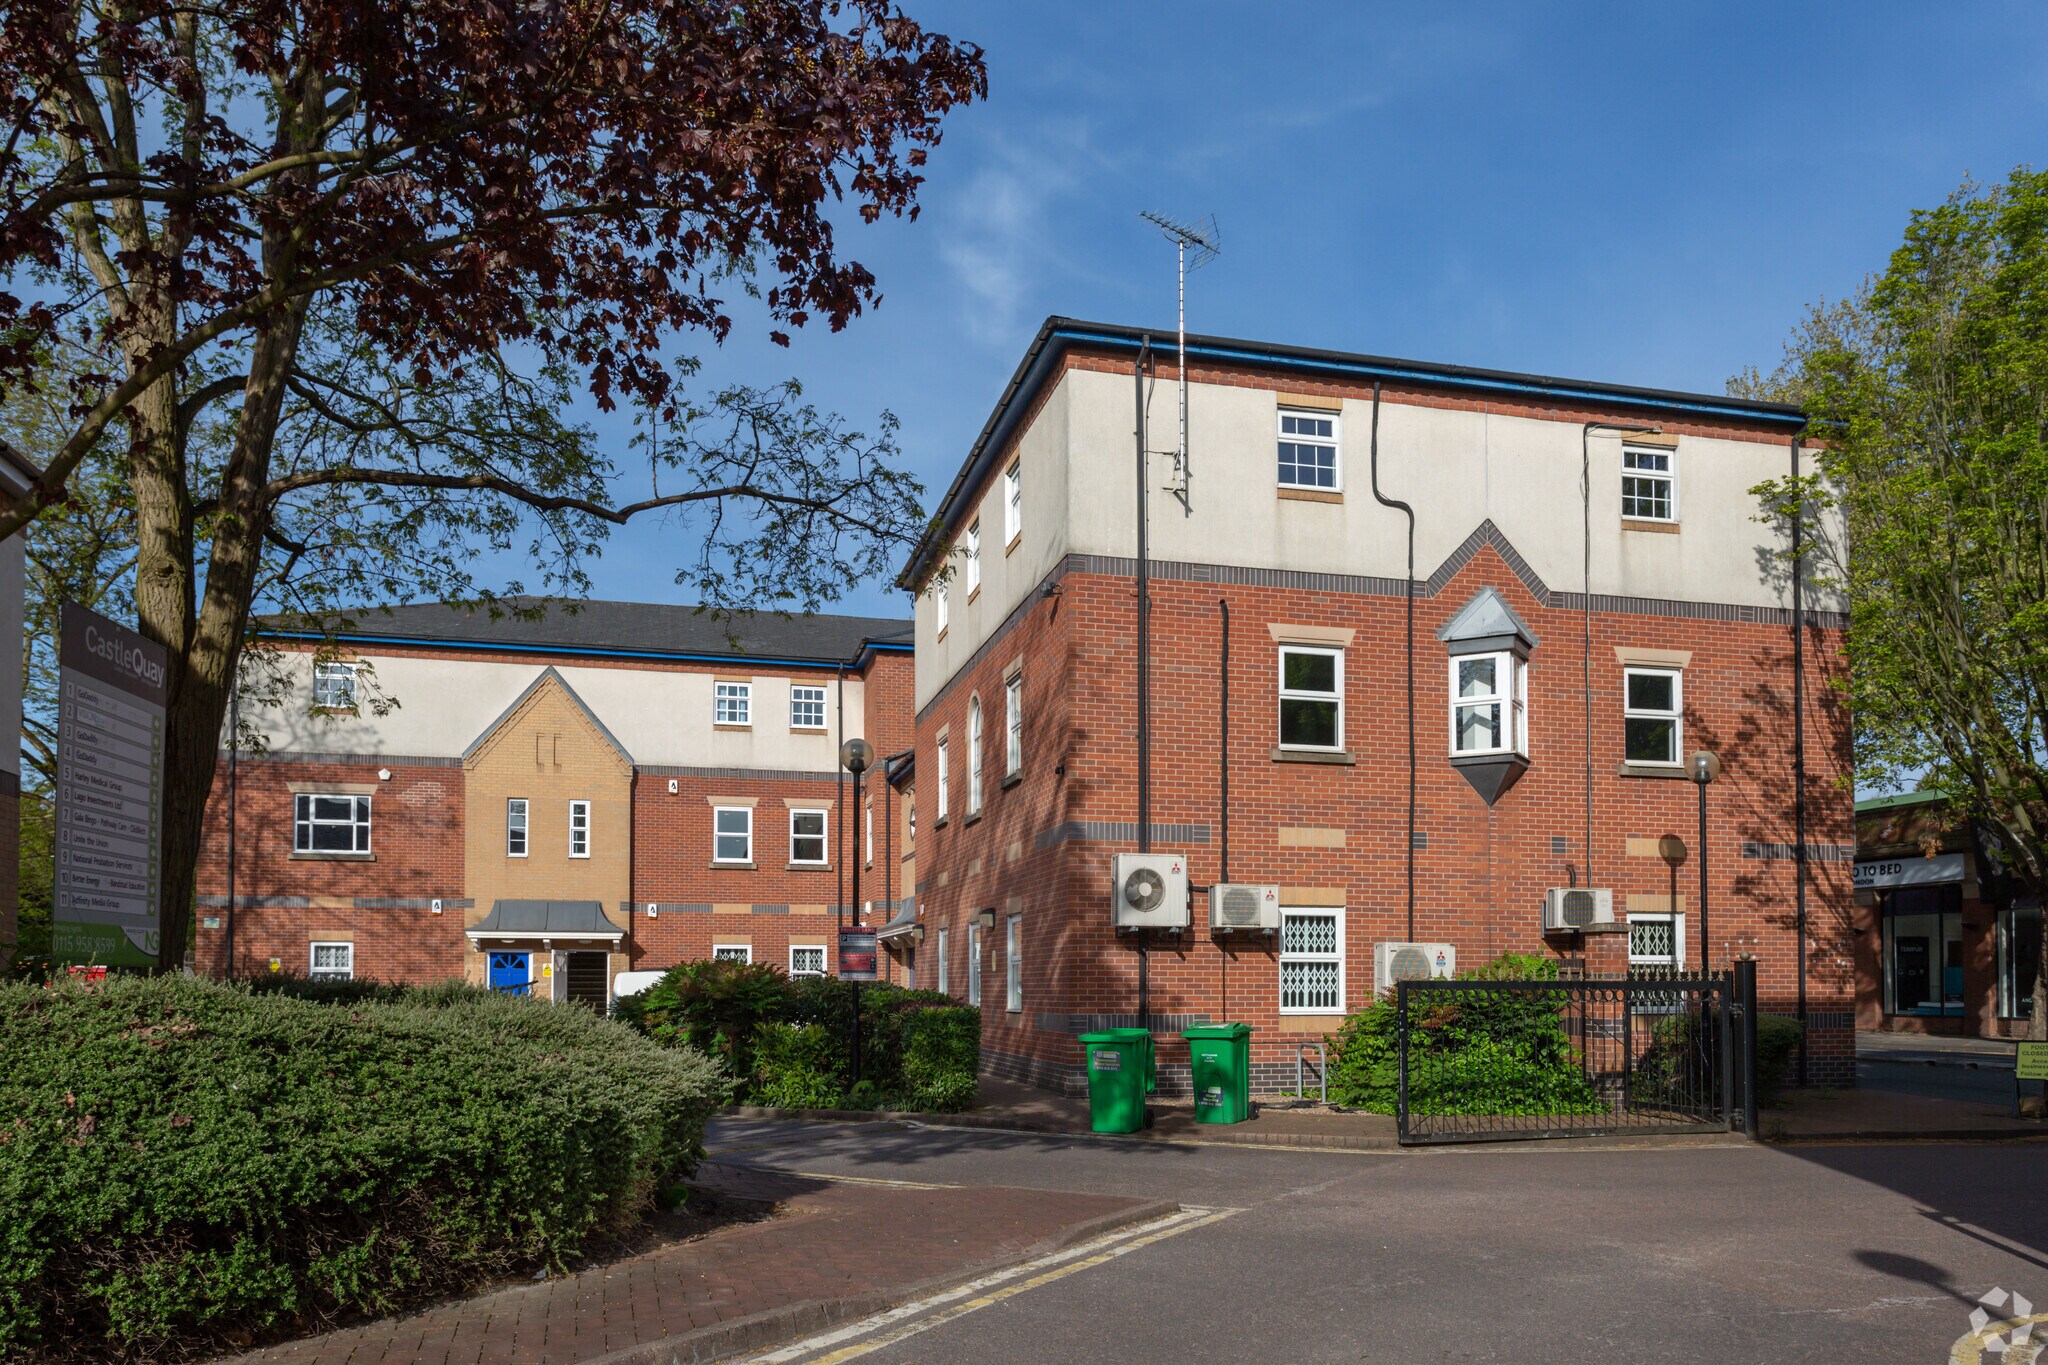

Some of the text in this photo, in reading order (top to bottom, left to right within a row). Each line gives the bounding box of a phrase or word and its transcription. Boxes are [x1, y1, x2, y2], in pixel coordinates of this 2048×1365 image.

[68, 684, 98, 706] 1 GoDaddy
[67, 704, 72, 715] 2
[66, 724, 71, 735] 3
[76, 730, 98, 745] GoDaddy
[65, 746, 97, 765] 4 GoDaddy
[65, 767, 122, 793] 5 Harley Medical Group
[64, 788, 69, 799] 6
[64, 809, 69, 819] 7
[63, 830, 109, 848] 8 Unite the Union
[63, 851, 133, 870] 9 National Probation Services
[61, 872, 68, 883] 10
[1862, 865, 1877, 877] TO
[1880, 863, 1902, 876] BED
[61, 893, 67, 905] 11
[92, 897, 105, 907] Media
[106, 898, 120, 911] Group
[52, 934, 116, 954] 0115 958 8599
